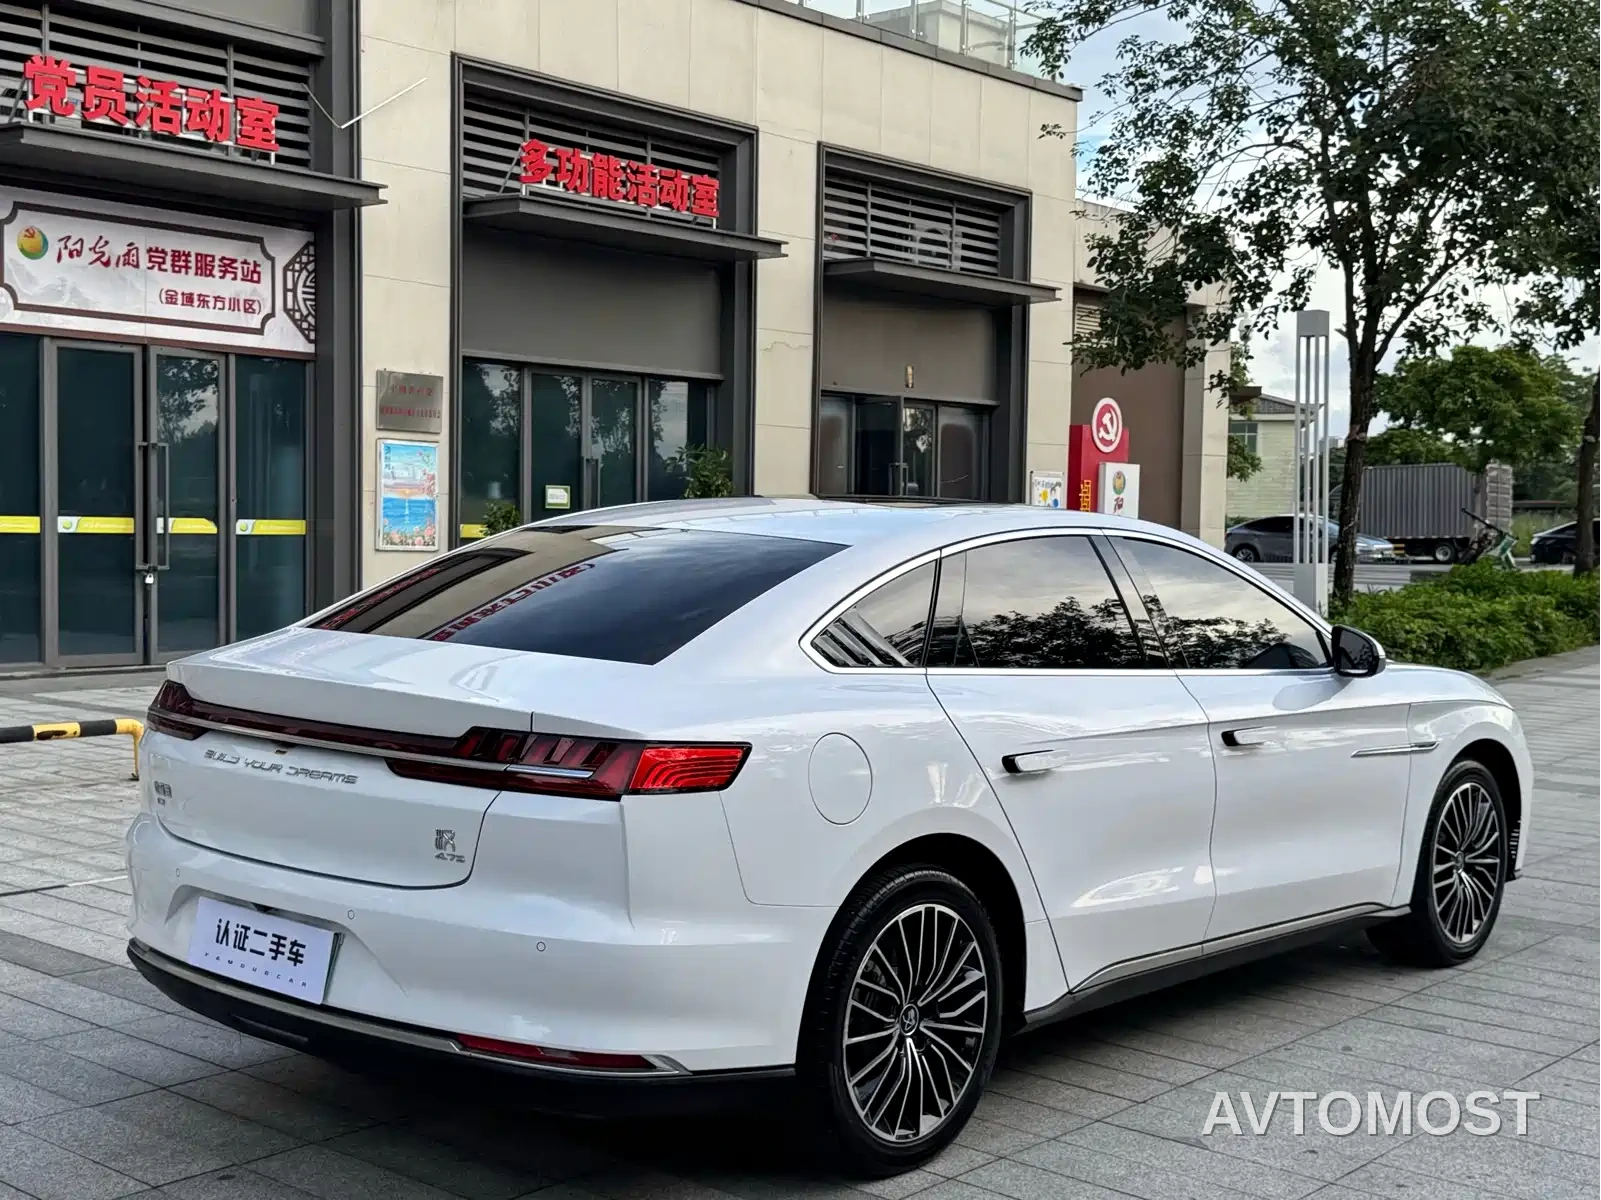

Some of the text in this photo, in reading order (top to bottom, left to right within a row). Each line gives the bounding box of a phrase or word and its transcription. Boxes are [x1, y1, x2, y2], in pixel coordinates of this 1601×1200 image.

[23, 55, 280, 152] 党员活动室
[519, 138, 720, 218] 多功能活动室
[203, 749, 359, 785] BUILD YOUR DREAMS
[215, 918, 307, 967] 认证二手车
